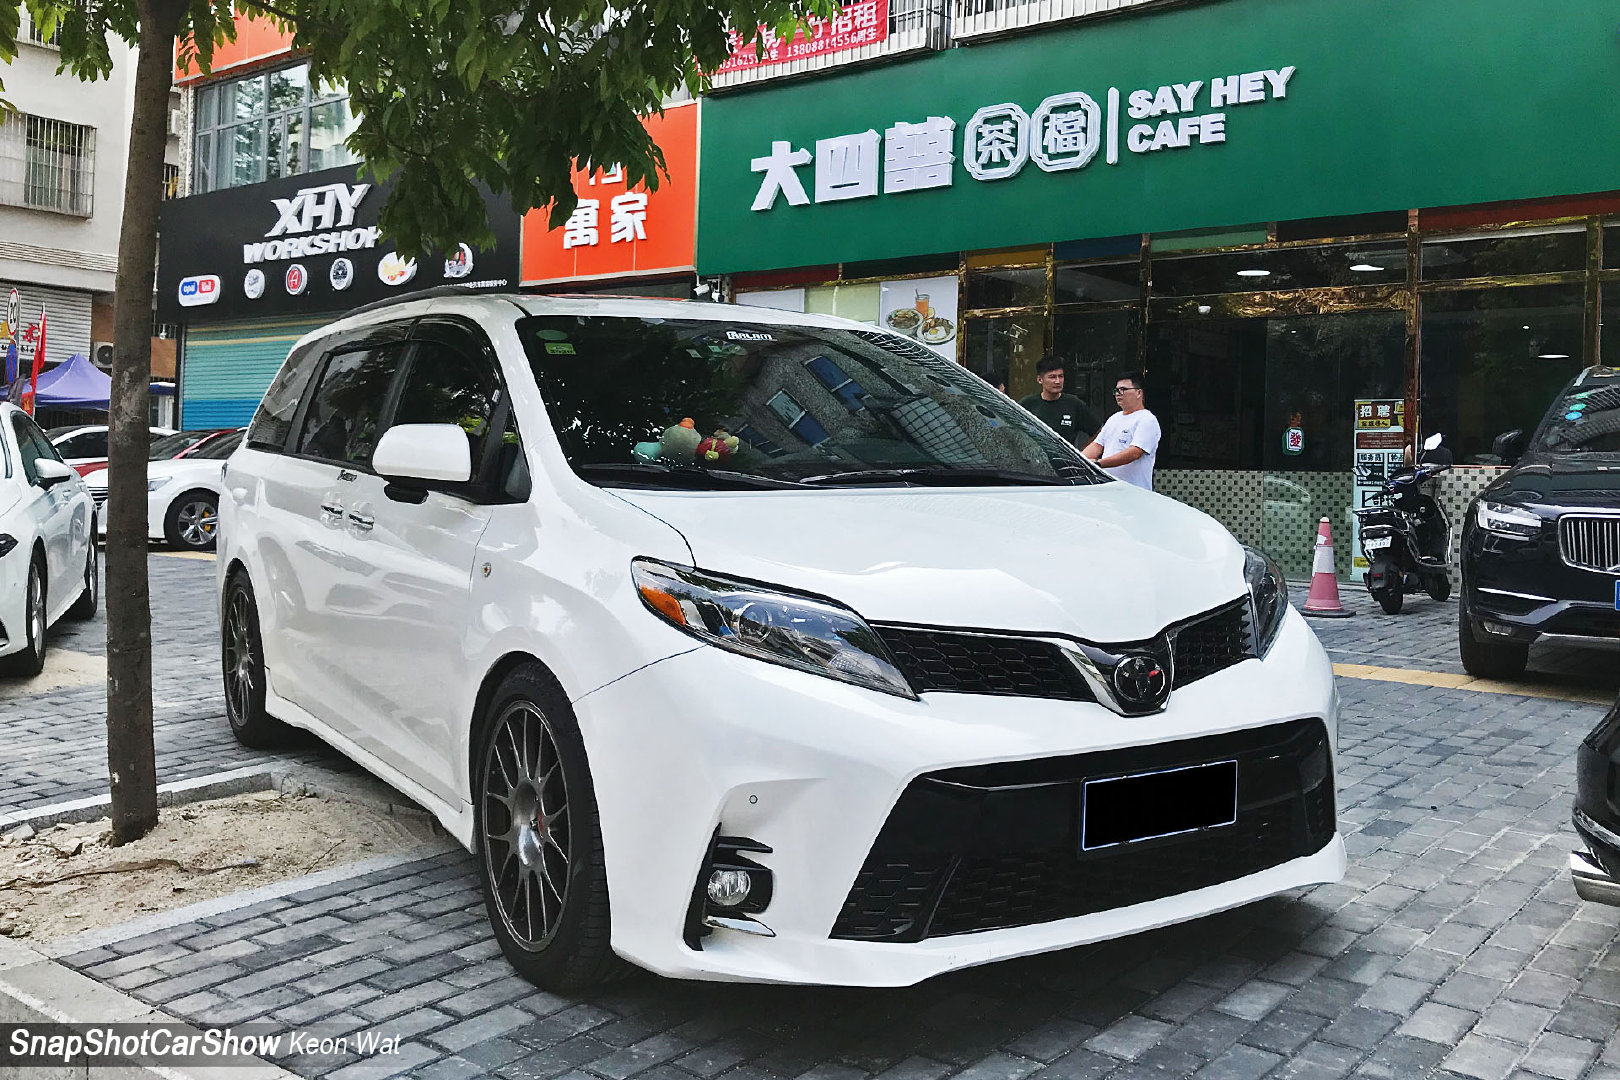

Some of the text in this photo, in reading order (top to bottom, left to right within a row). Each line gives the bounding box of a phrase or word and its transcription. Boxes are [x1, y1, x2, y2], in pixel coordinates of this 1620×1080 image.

[1128, 66, 1296, 119] SAY HEY
[1127, 113, 1226, 152] CAFE
[264, 183, 371, 238] XHY
[1360, 404, 1391, 418] 招聘
